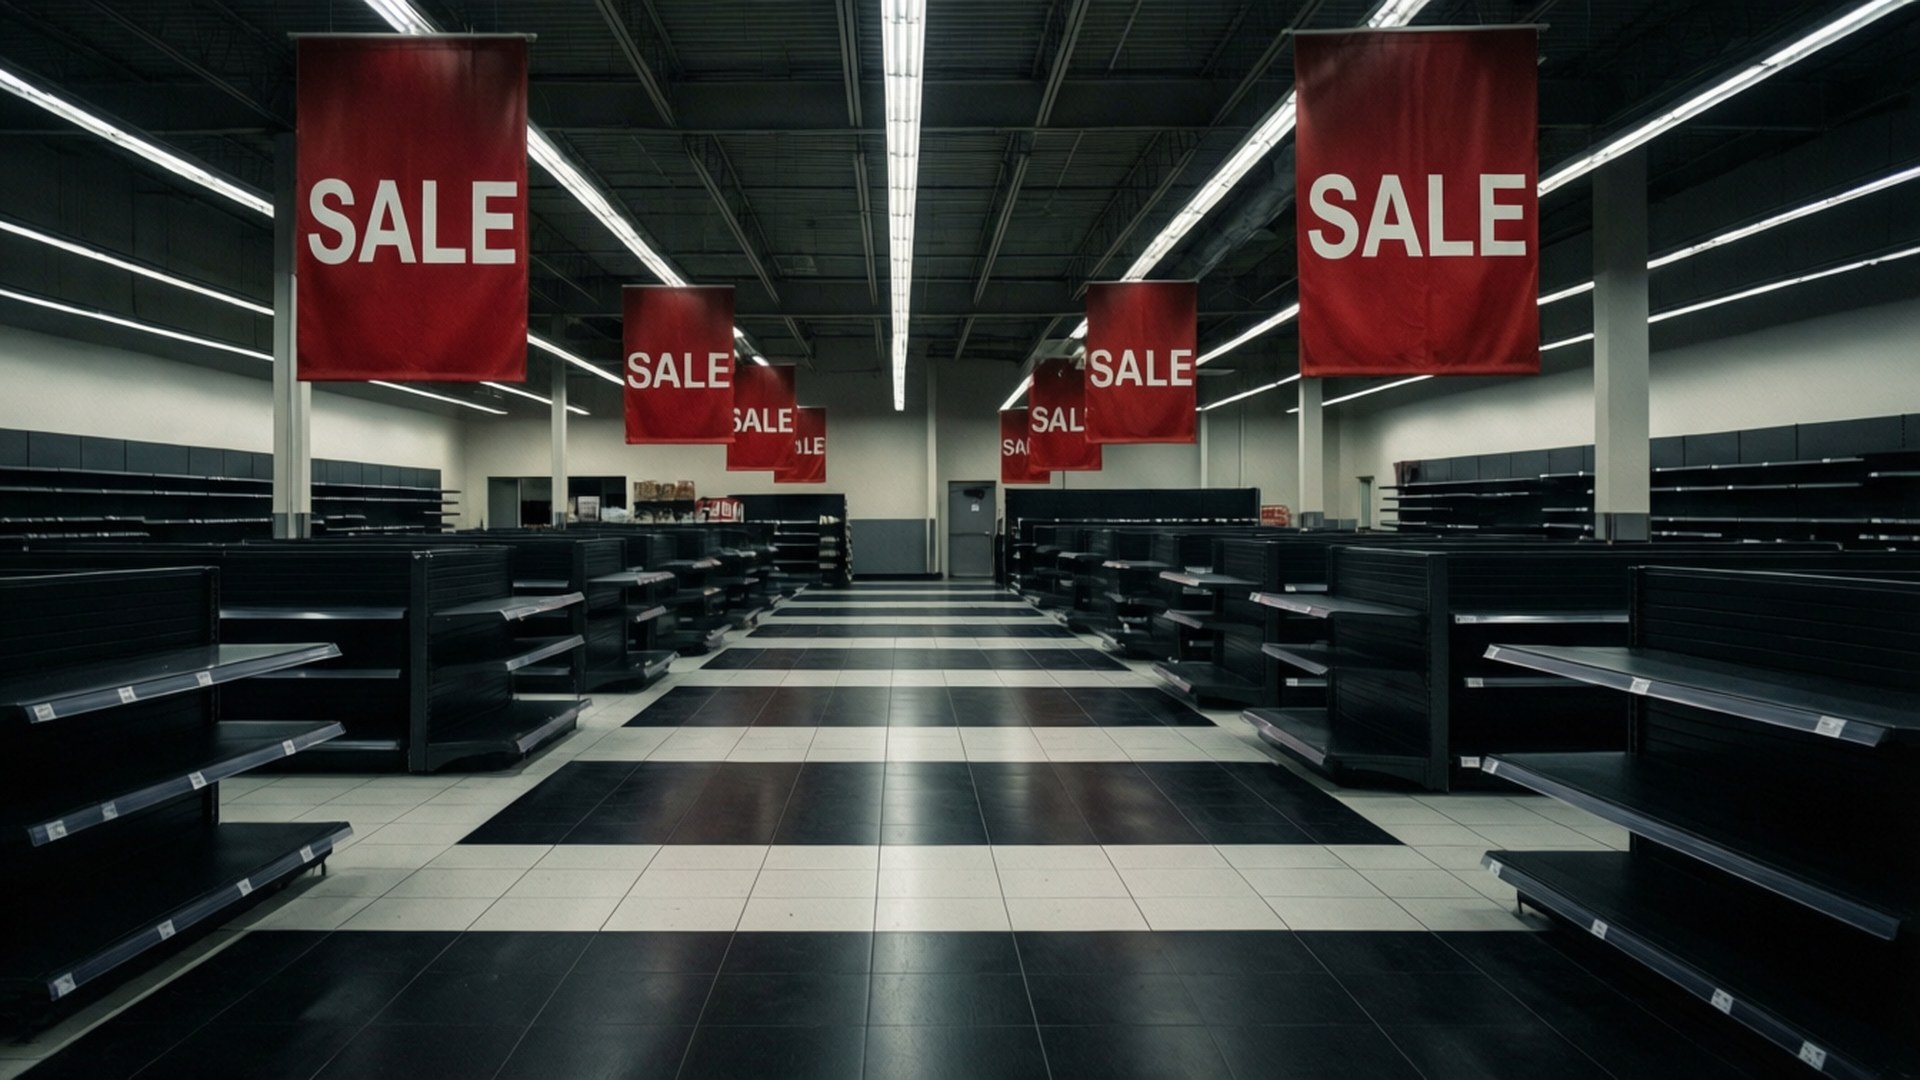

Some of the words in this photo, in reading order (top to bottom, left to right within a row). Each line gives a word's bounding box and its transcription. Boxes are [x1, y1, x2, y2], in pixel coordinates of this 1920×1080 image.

[307, 178, 518, 265] SALE
[1307, 173, 1527, 260] SALE
[626, 352, 730, 389] SALE
[1090, 349, 1193, 388] SALE
[1031, 406, 1085, 433] SAL
[795, 437, 825, 455] LE
[1002, 438, 1031, 456] SA
